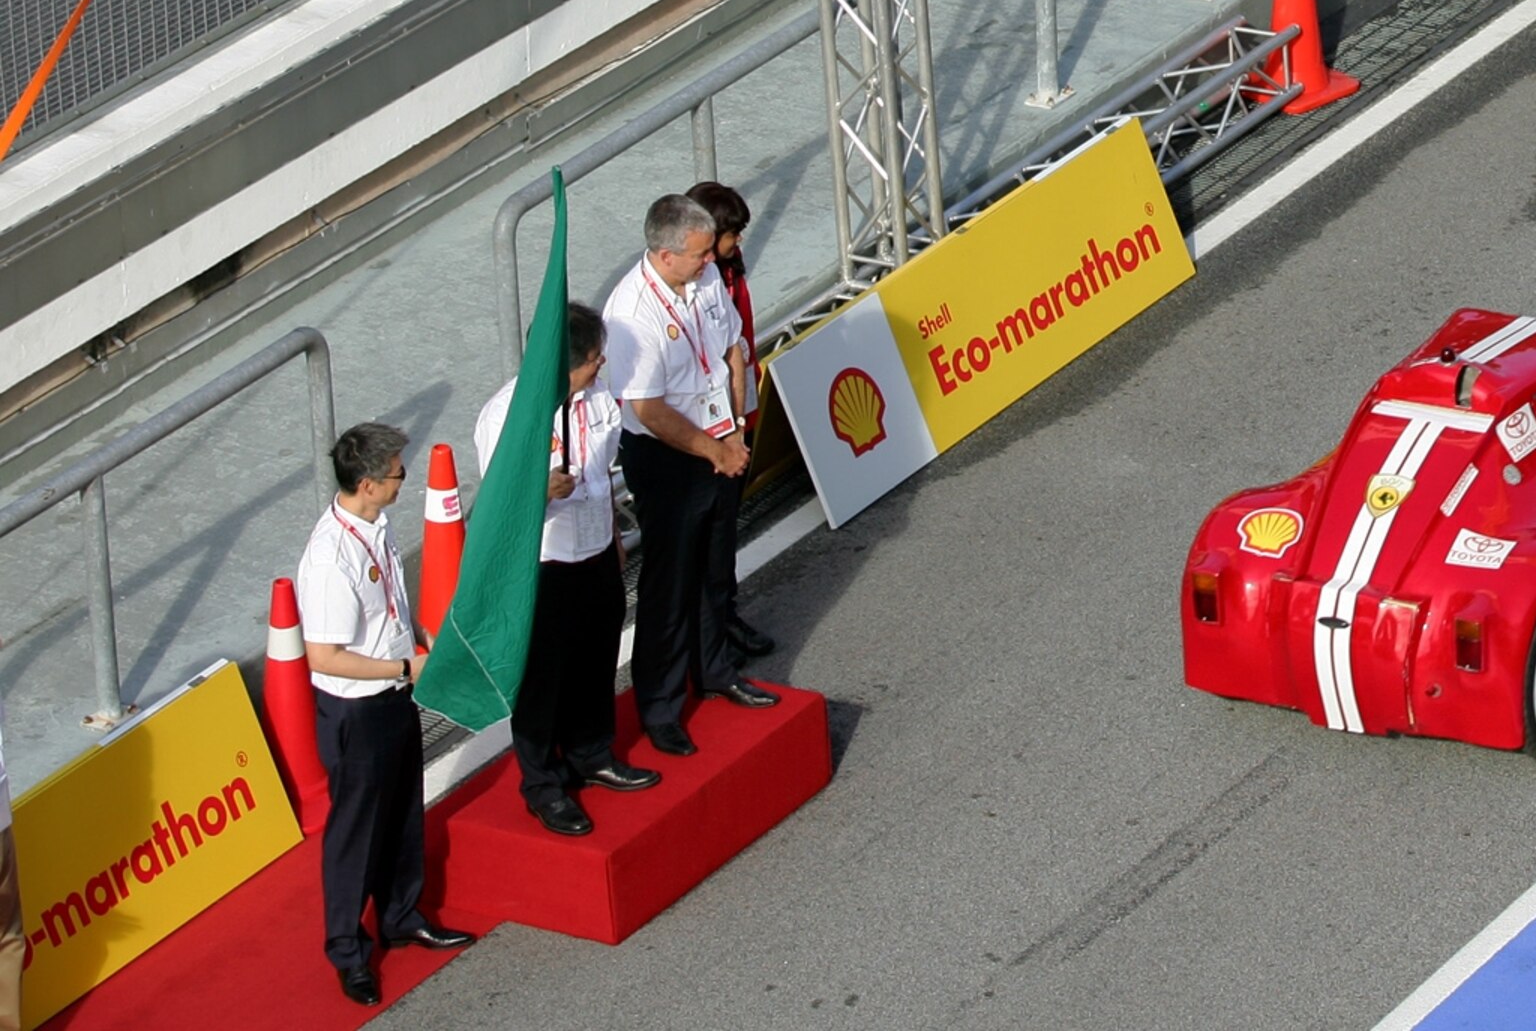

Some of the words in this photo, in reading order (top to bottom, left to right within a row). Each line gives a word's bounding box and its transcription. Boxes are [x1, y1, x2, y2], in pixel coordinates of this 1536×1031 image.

[917, 303, 953, 340] Shell
[927, 223, 1162, 397] Eco-marathon
[1450, 549, 1501, 565] TOYOTA
